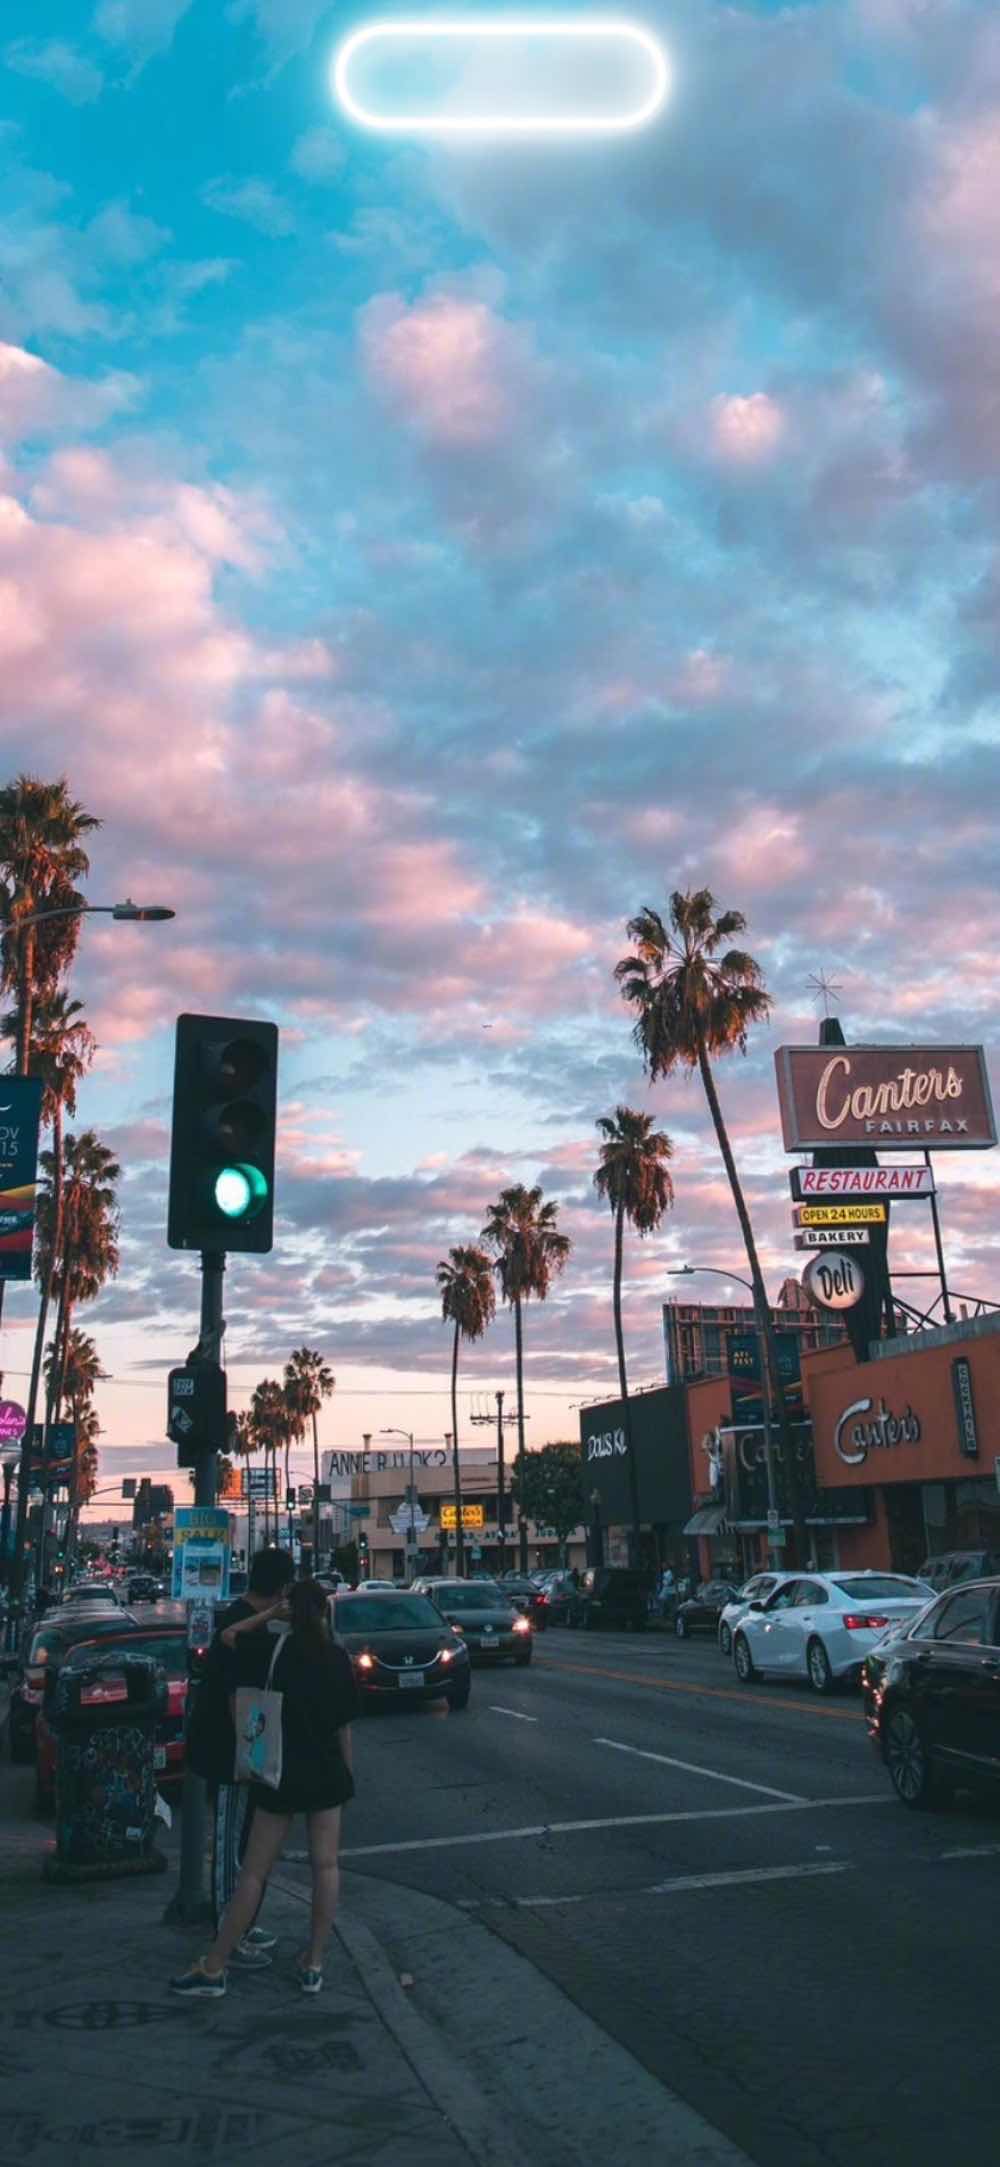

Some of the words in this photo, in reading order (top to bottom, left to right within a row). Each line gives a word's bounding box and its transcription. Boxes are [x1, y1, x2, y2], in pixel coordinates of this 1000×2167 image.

[865, 1119, 969, 1133] FAIRFAX
[803, 1170, 928, 1191] RESTAURANT
[803, 1209, 829, 1221] OPEN
[830, 1209, 847, 1220] 24
[848, 1207, 881, 1219] HOURS
[808, 1231, 865, 1243] BAKERY
[817, 1258, 855, 1300] Deli
